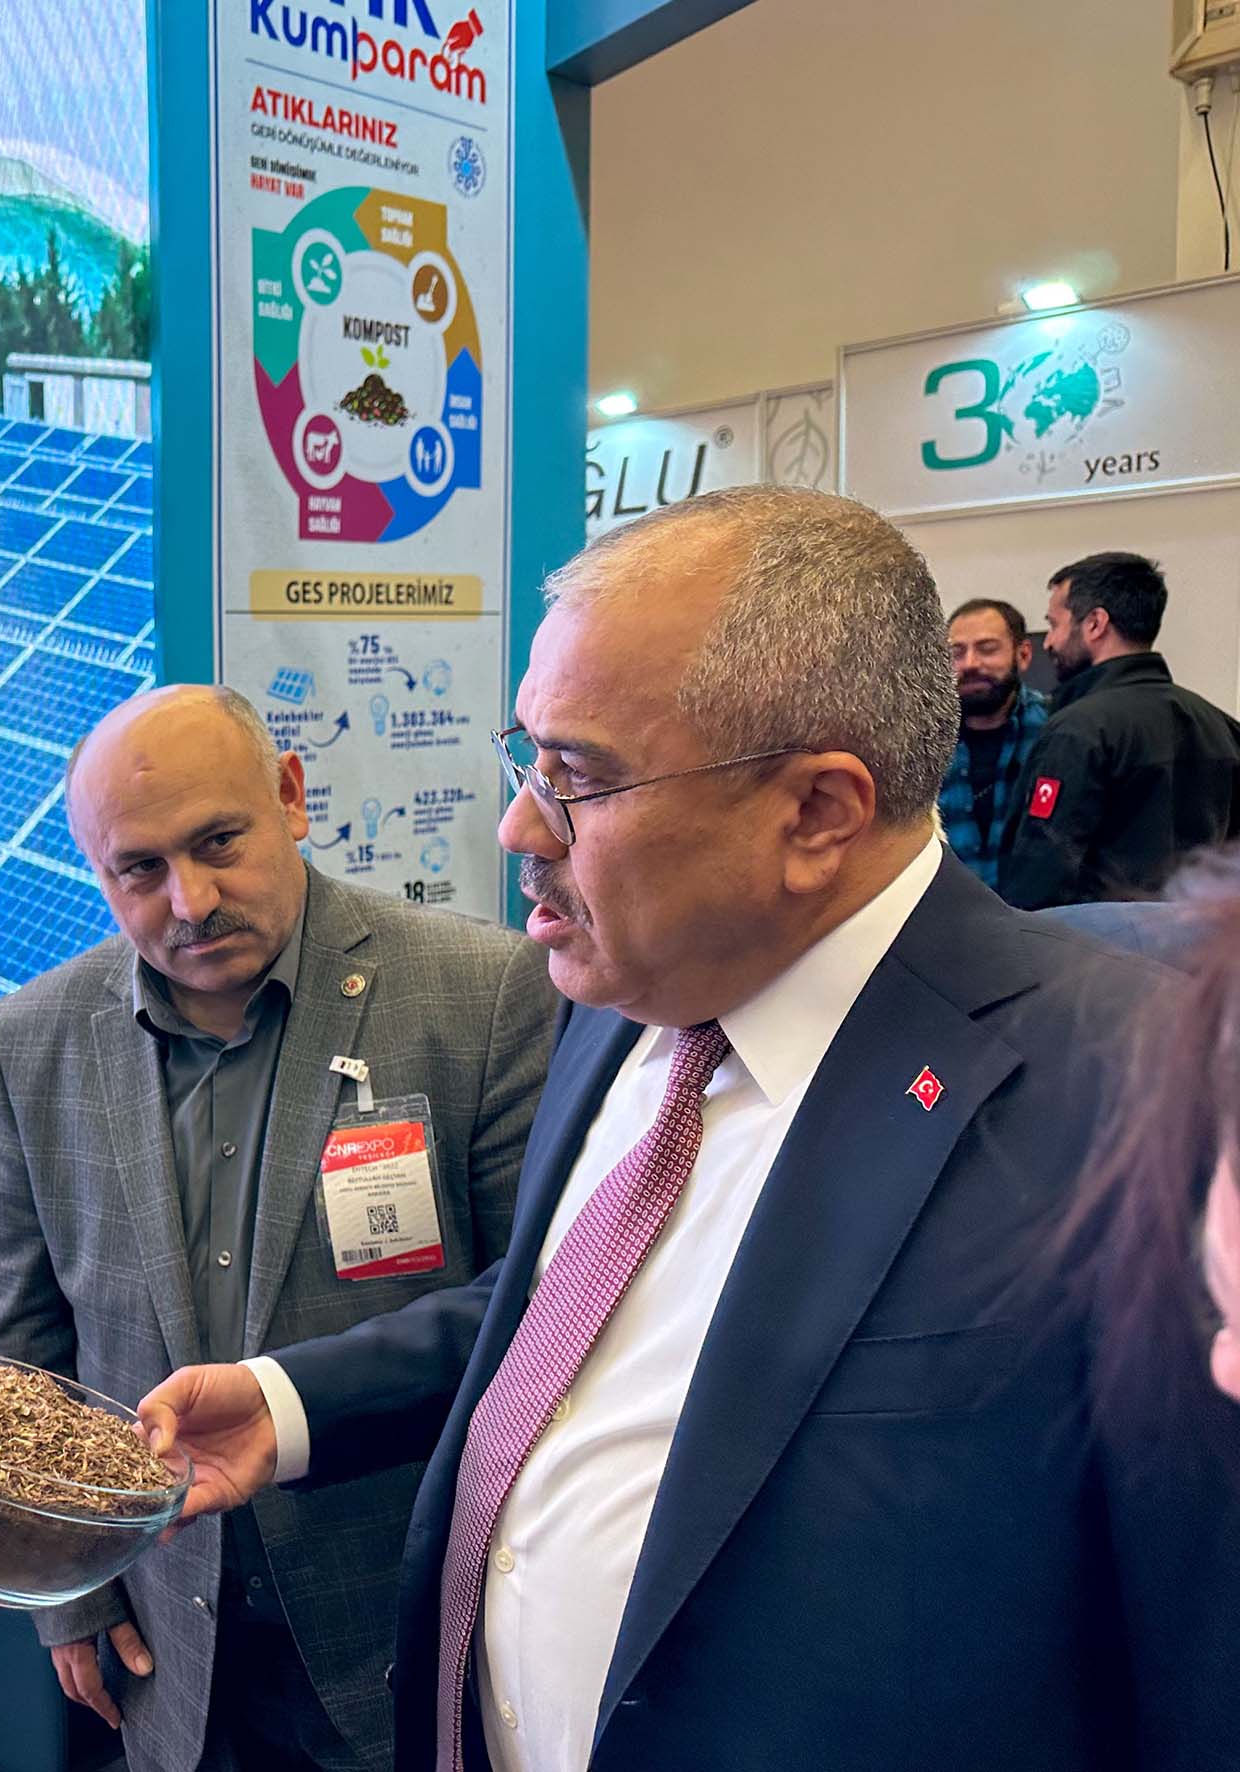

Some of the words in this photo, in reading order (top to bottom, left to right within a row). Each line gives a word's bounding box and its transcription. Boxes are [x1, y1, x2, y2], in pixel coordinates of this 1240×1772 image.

[251, 86, 398, 149] ATIKLARINIZ
[343, 315, 411, 349] KOMPOST
[1084, 450, 1160, 483] years
[286, 581, 324, 604] GES
[329, 577, 454, 605] PROJELERİMİZ
